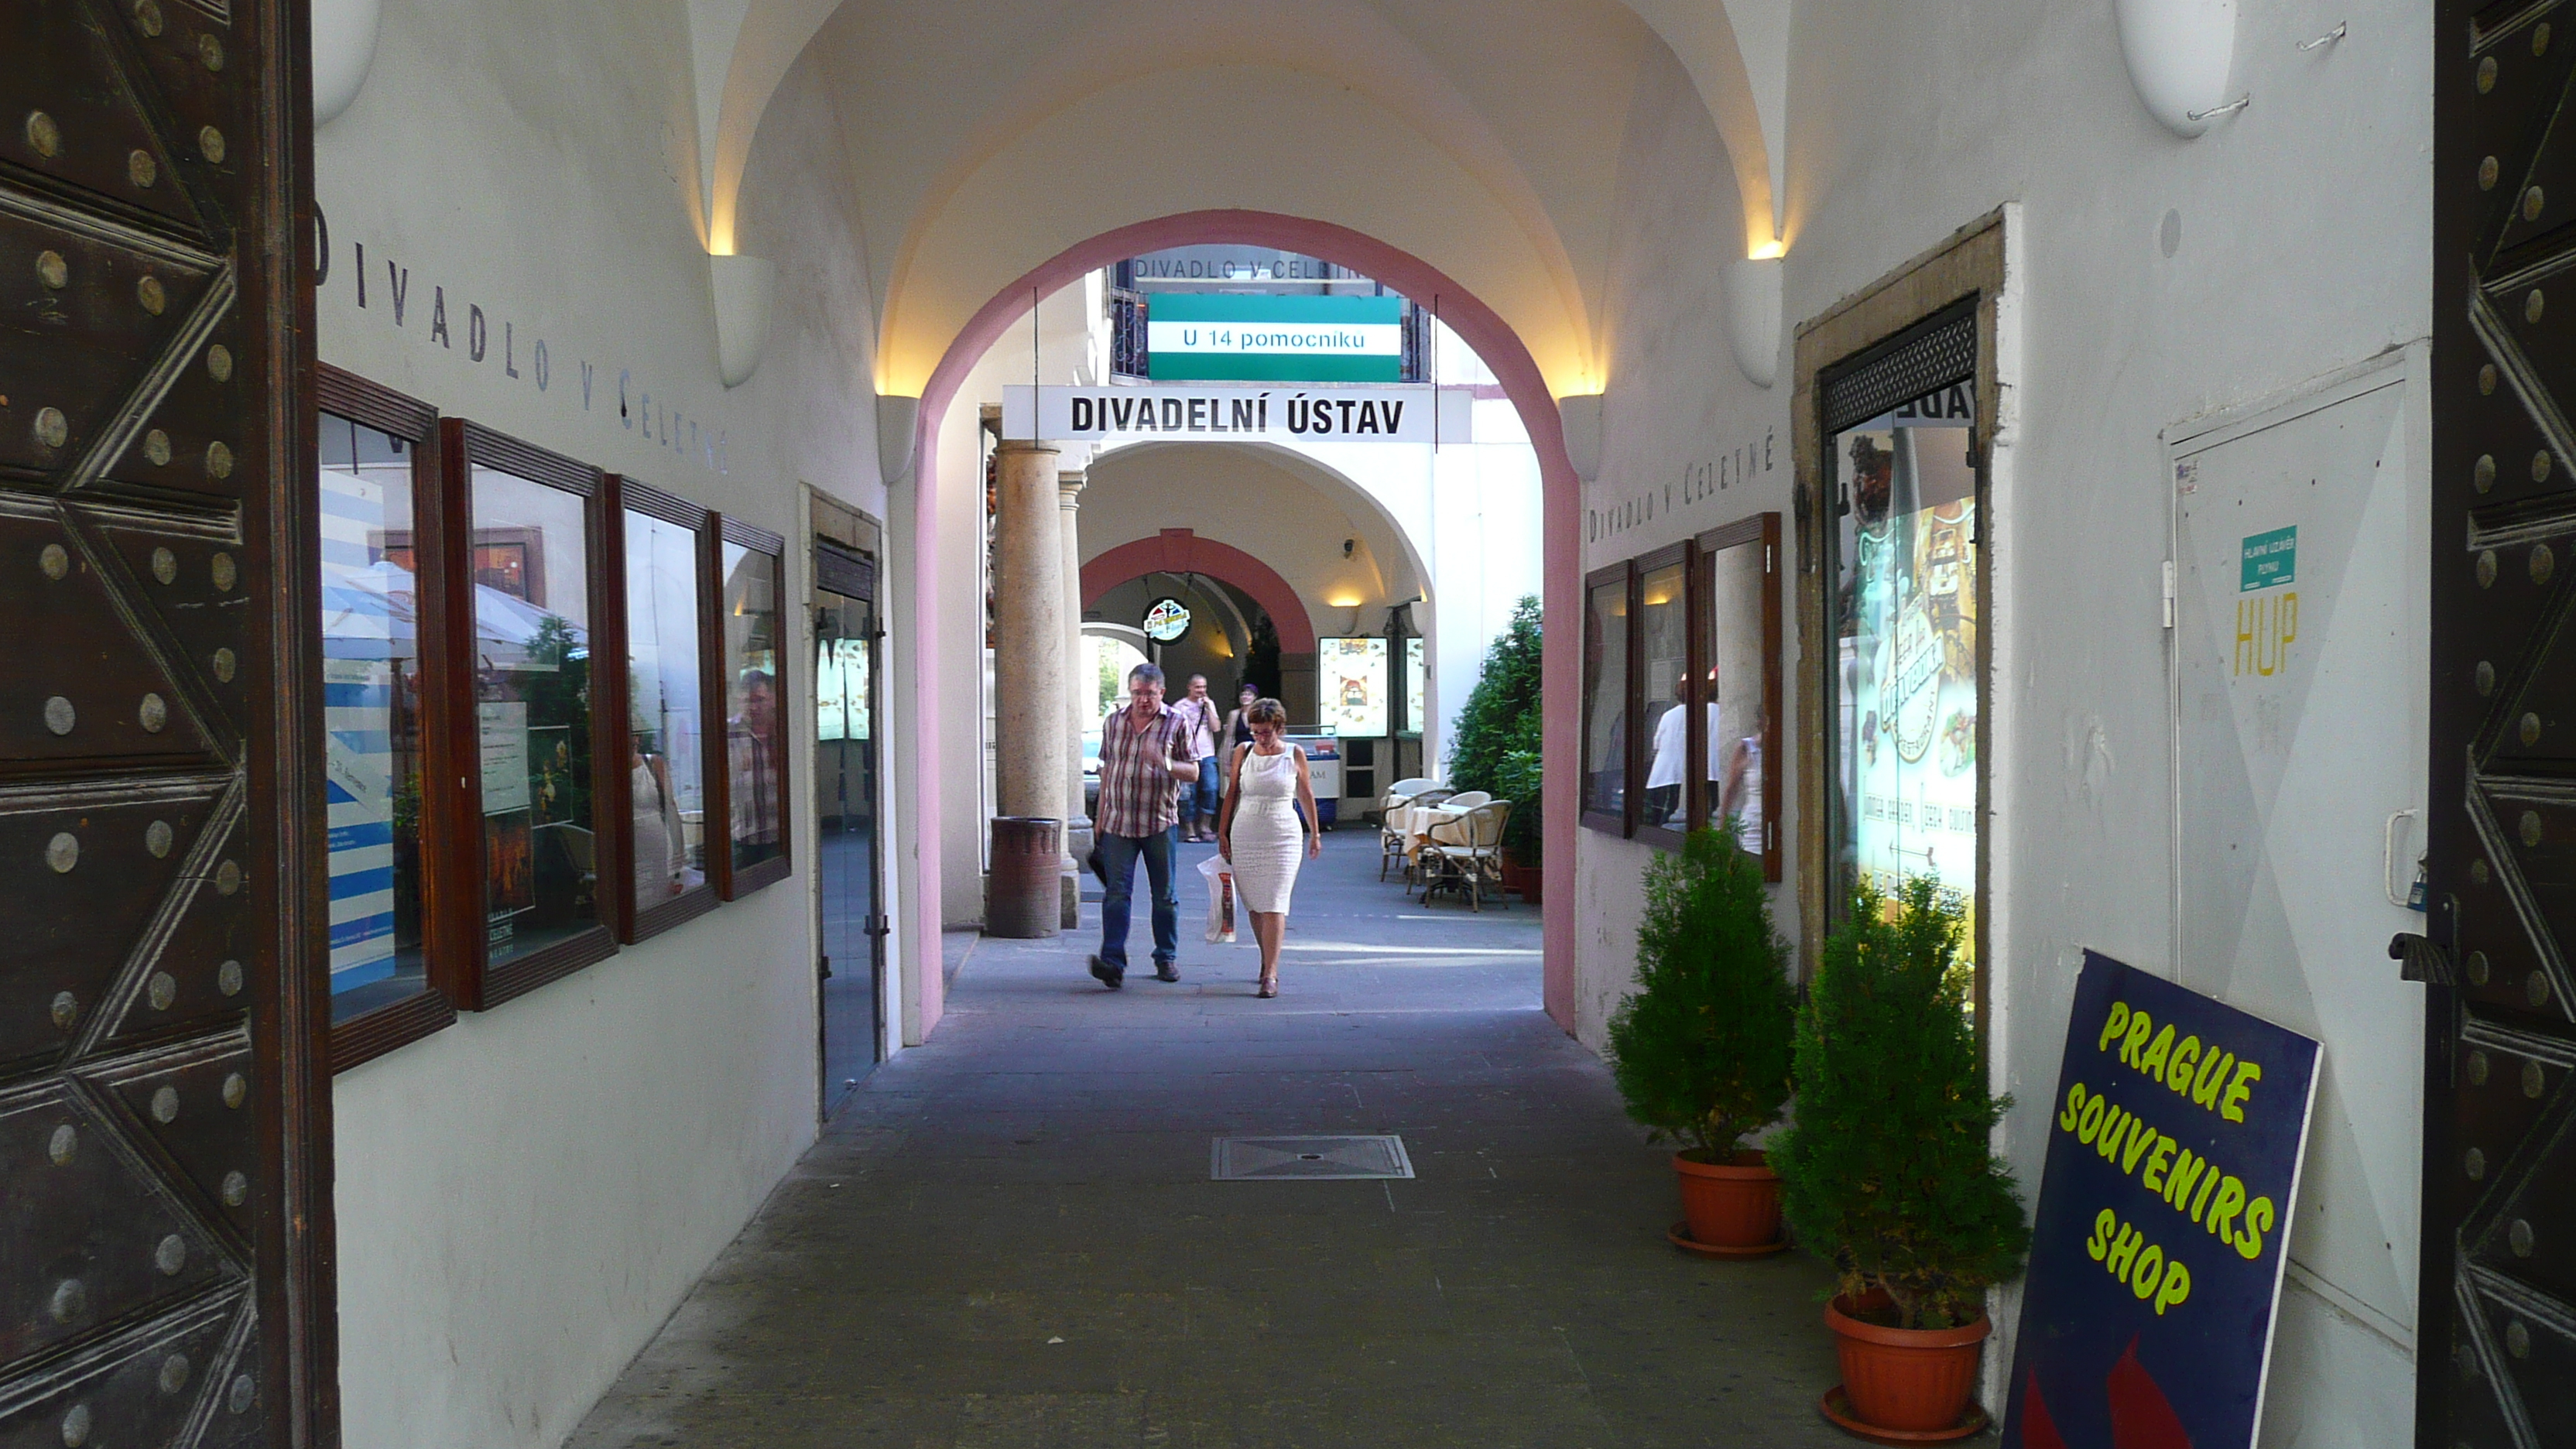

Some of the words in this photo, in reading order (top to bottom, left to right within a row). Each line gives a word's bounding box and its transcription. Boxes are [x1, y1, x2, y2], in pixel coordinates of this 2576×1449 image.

[1135, 259, 1236, 279] DIVADLO
[1249, 260, 1262, 279] V
[1184, 329, 1197, 347] U
[1209, 330, 1232, 347] 14
[580, 360, 593, 411] V
[1071, 392, 1270, 433] DIVADELNÍ
[1286, 392, 1404, 435] ÚSTAV
[1589, 492, 1654, 543] DIVADLO
[2234, 592, 2298, 677] HUP
[2098, 1002, 2262, 1124] PRAGUE
[2059, 1082, 2275, 1260] SOUVENIRS
[2087, 1208, 2191, 1316] SHOP
